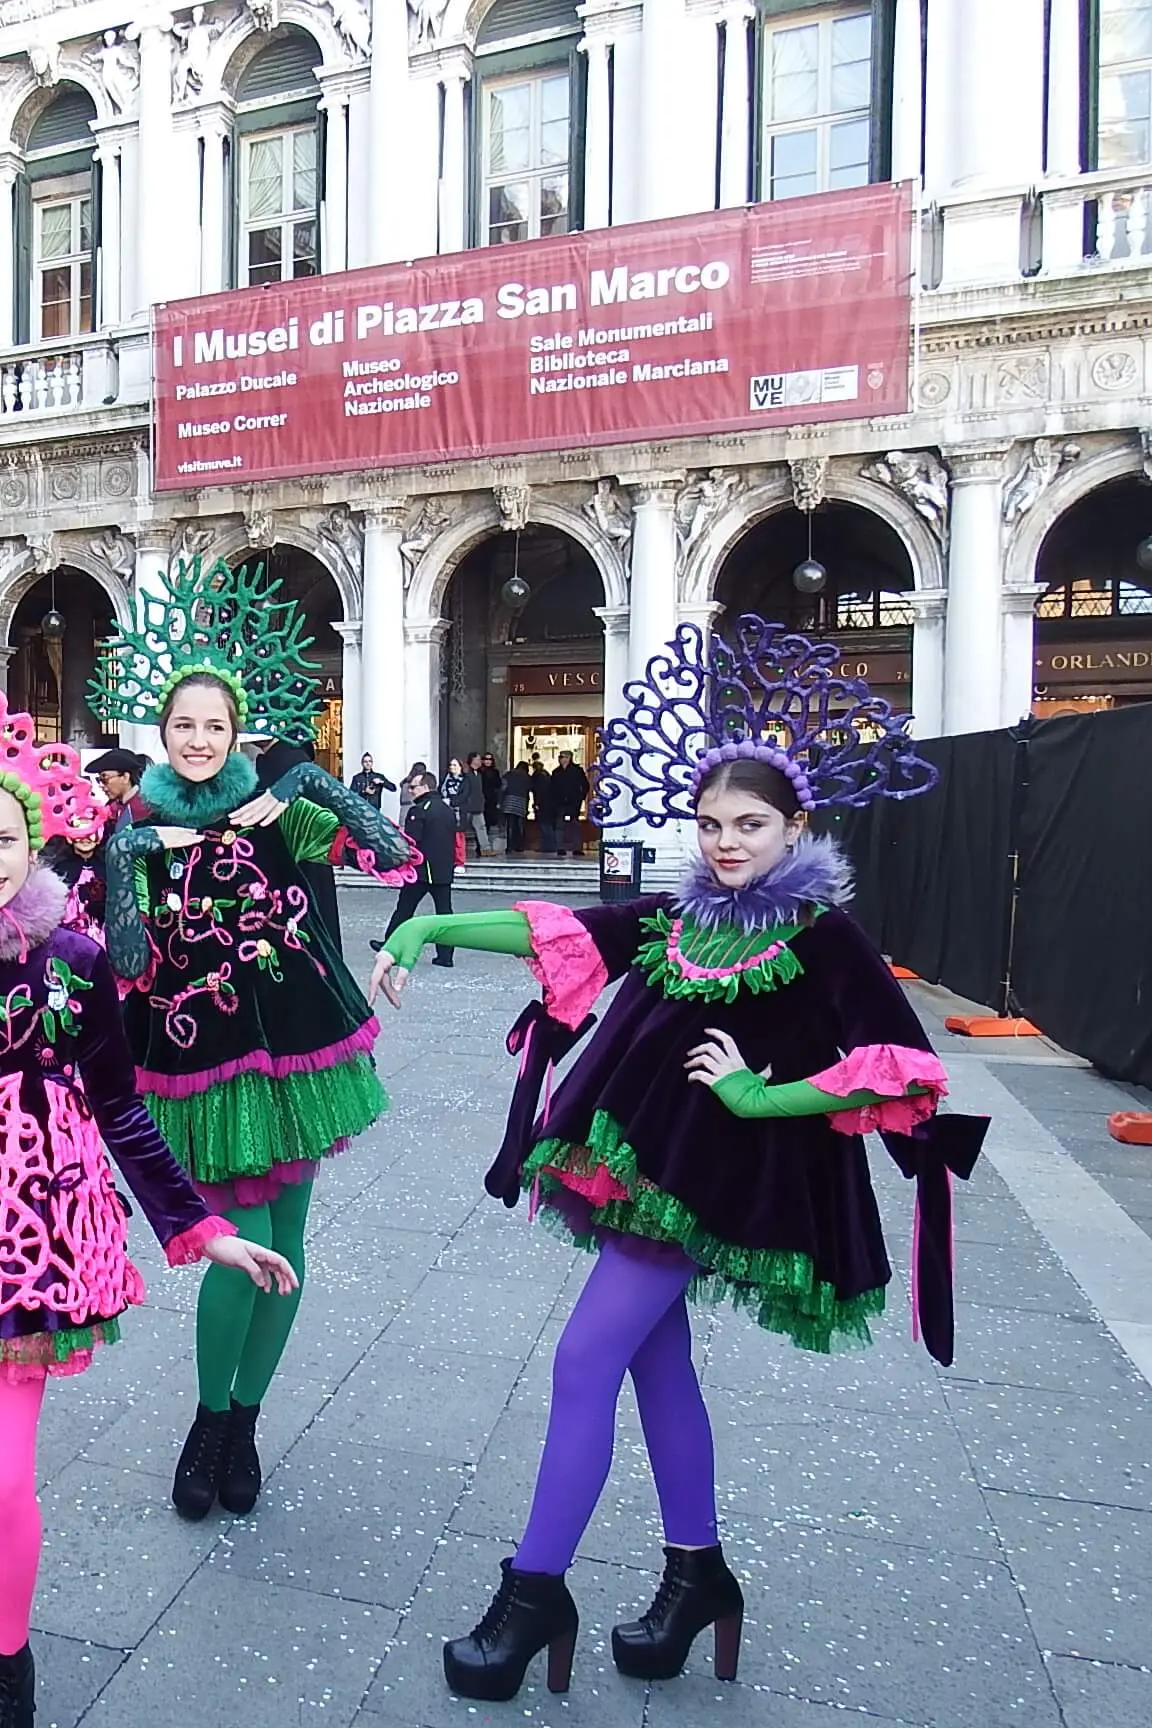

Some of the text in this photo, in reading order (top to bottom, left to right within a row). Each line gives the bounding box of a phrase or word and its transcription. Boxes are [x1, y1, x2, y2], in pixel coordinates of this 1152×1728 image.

[173, 335, 183, 367] I
[194, 317, 299, 364] Musei
[309, 309, 345, 346] di
[356, 296, 484, 340] Piazza
[496, 282, 577, 319] San
[590, 260, 730, 307] Marco
[529, 311, 713, 353] Sale Monumentali
[342, 356, 401, 378] Museo
[529, 347, 631, 374] Biblioteca
[176, 370, 297, 401] Palazzo Ducale
[342, 369, 459, 398] Archeologico
[529, 357, 730, 395] Nazionale Marciana
[753, 377, 783, 393] MU
[344, 392, 431, 417] Nazionale
[754, 391, 783, 406] VE
[178, 412, 288, 439] Museo Correr
[1050, 651, 1152, 670] ORLAND
